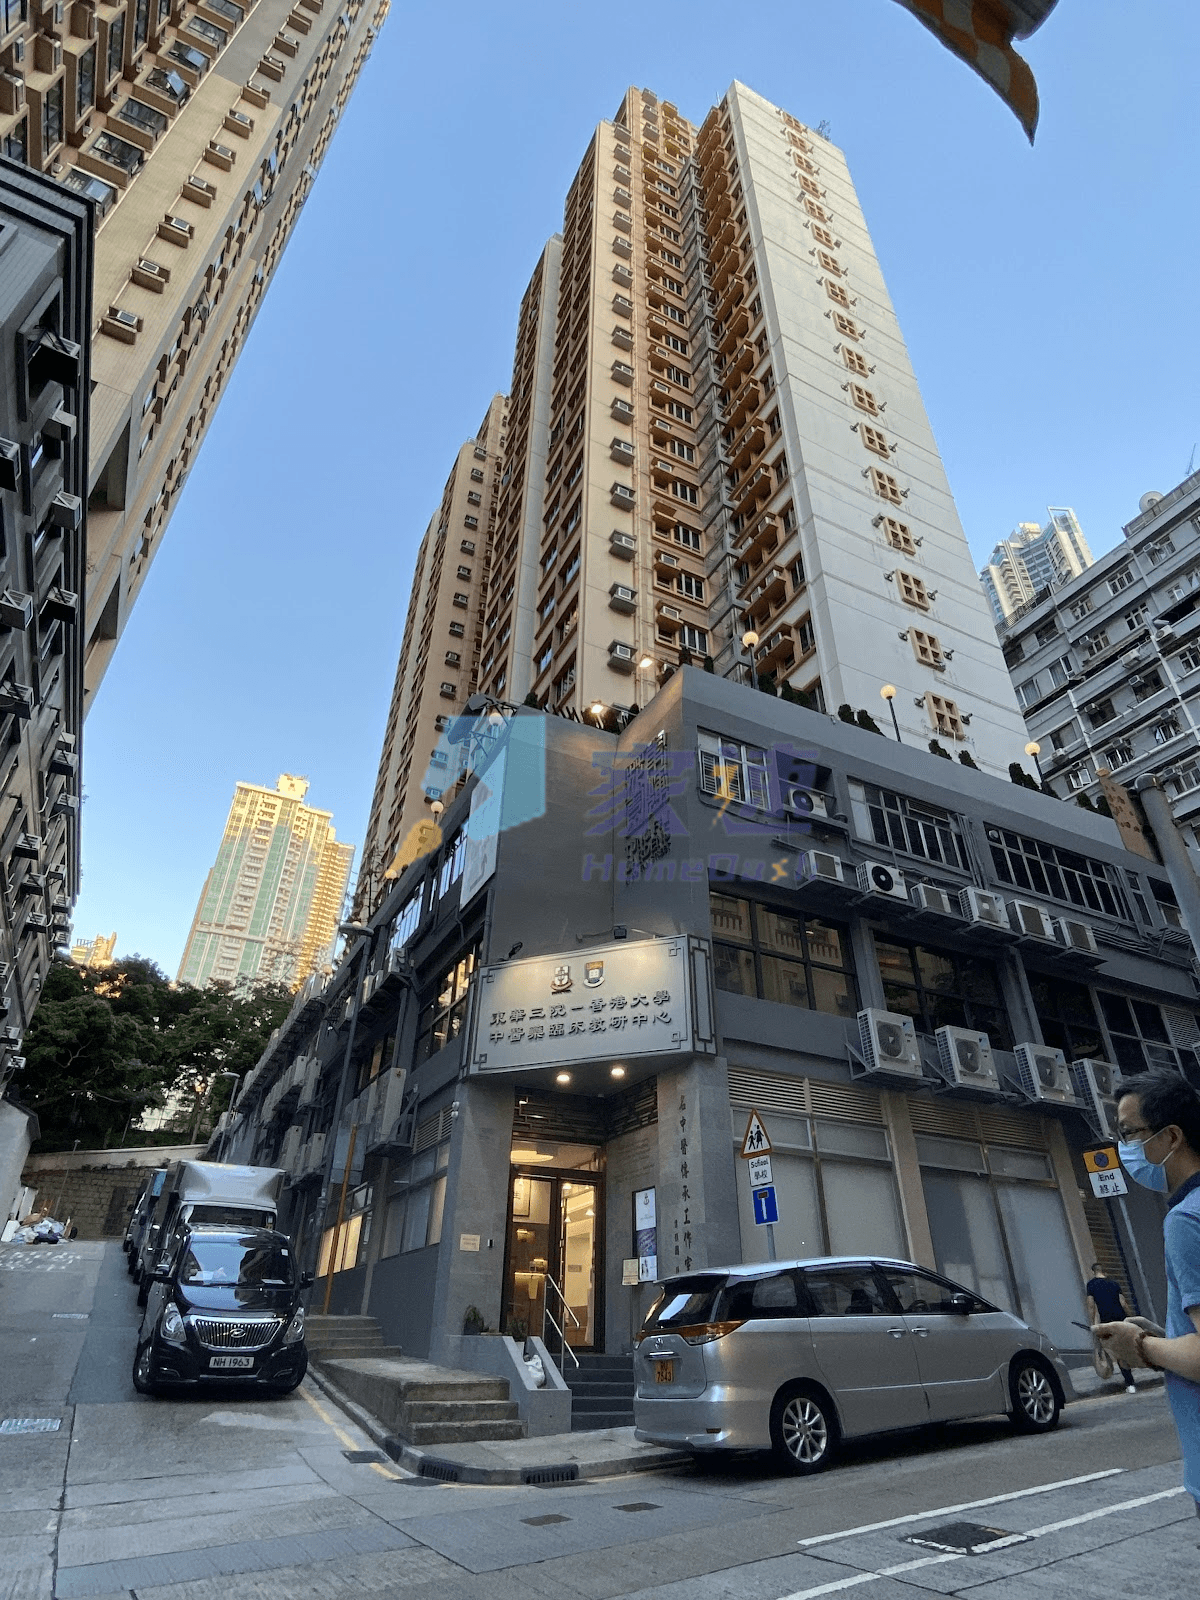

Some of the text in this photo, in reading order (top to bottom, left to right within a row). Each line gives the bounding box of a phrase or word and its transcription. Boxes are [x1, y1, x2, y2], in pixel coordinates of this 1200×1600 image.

[489, 1011, 672, 1045] 中醫藥臨床教研中心
[750, 1158, 769, 1169] School
[754, 1169, 768, 1181] 學校
[1098, 1172, 1115, 1182] End
[1099, 1182, 1121, 1194] 終止
[213, 1358, 250, 1367] NH 1963
